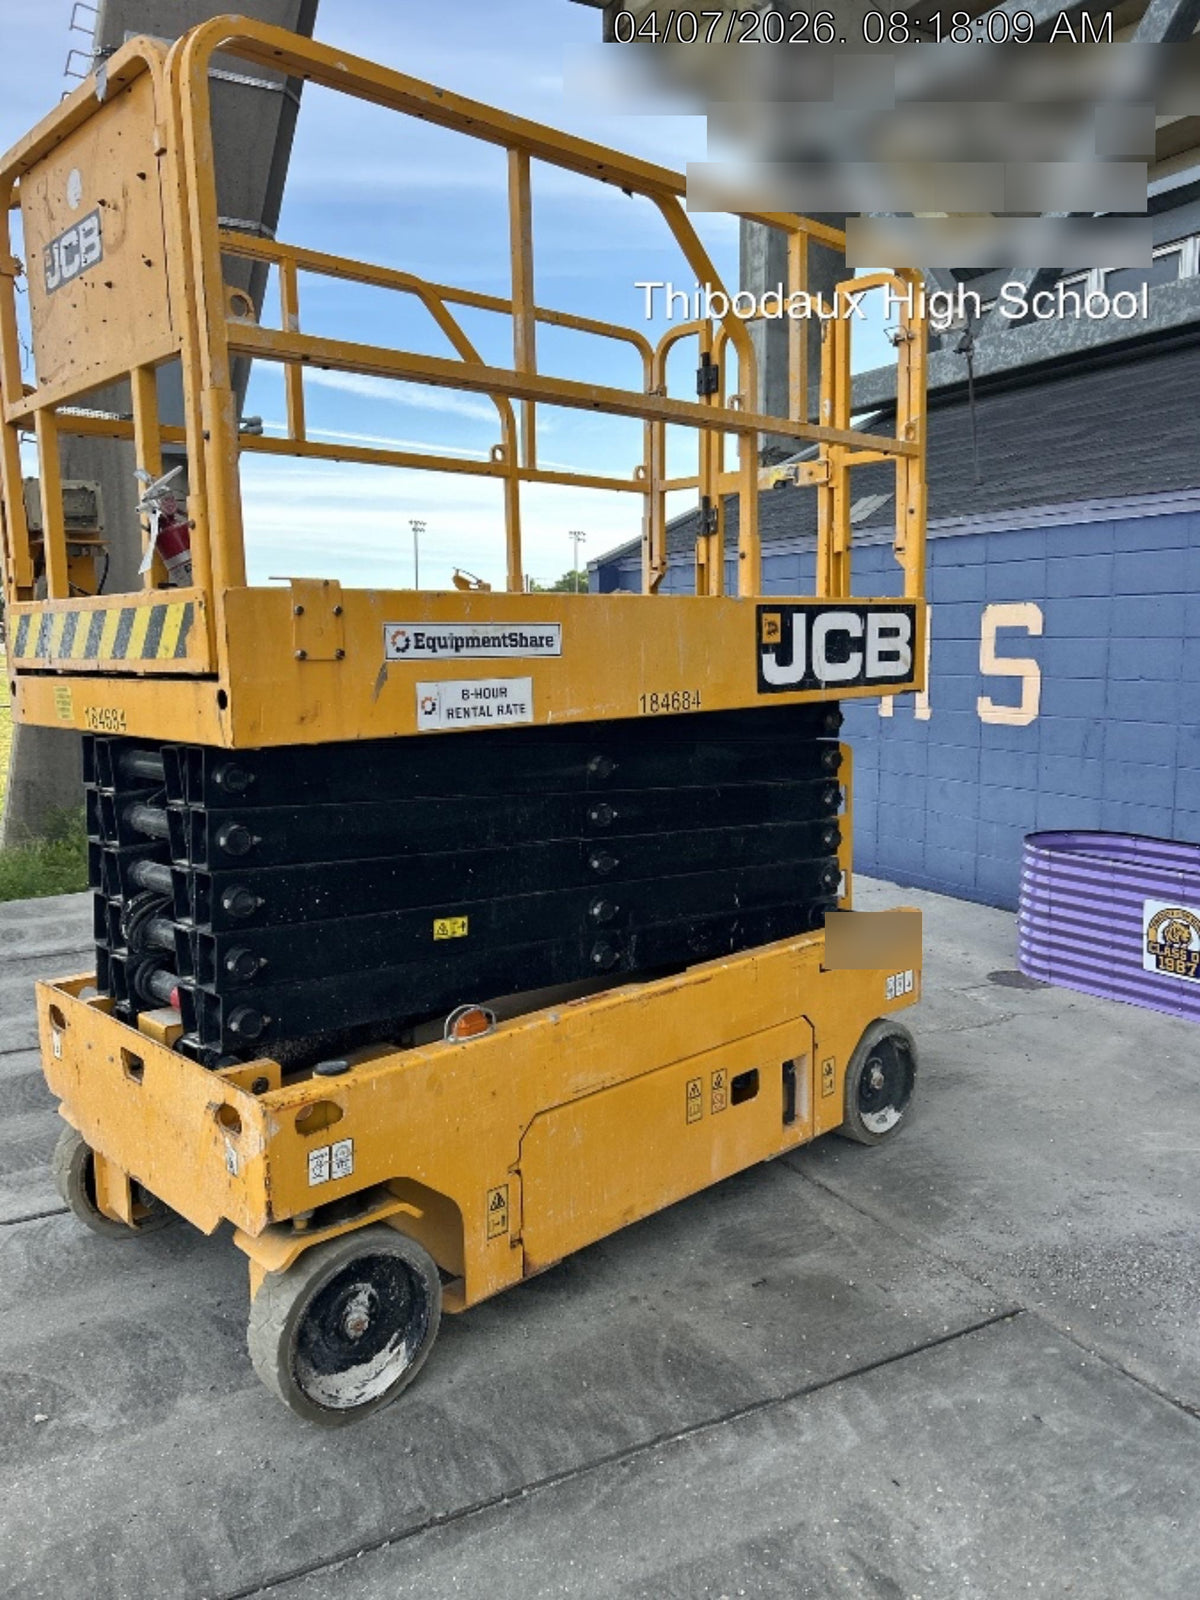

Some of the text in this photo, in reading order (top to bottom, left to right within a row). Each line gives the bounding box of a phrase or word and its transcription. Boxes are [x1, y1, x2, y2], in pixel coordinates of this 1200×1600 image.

[45, 215, 102, 290] JCB
[413, 631, 554, 653] EquipmentShare
[762, 611, 912, 685] JCB
[446, 703, 527, 720] RENTAL RATE
[639, 689, 702, 714] 184684
[1158, 955, 1198, 977] 1987
